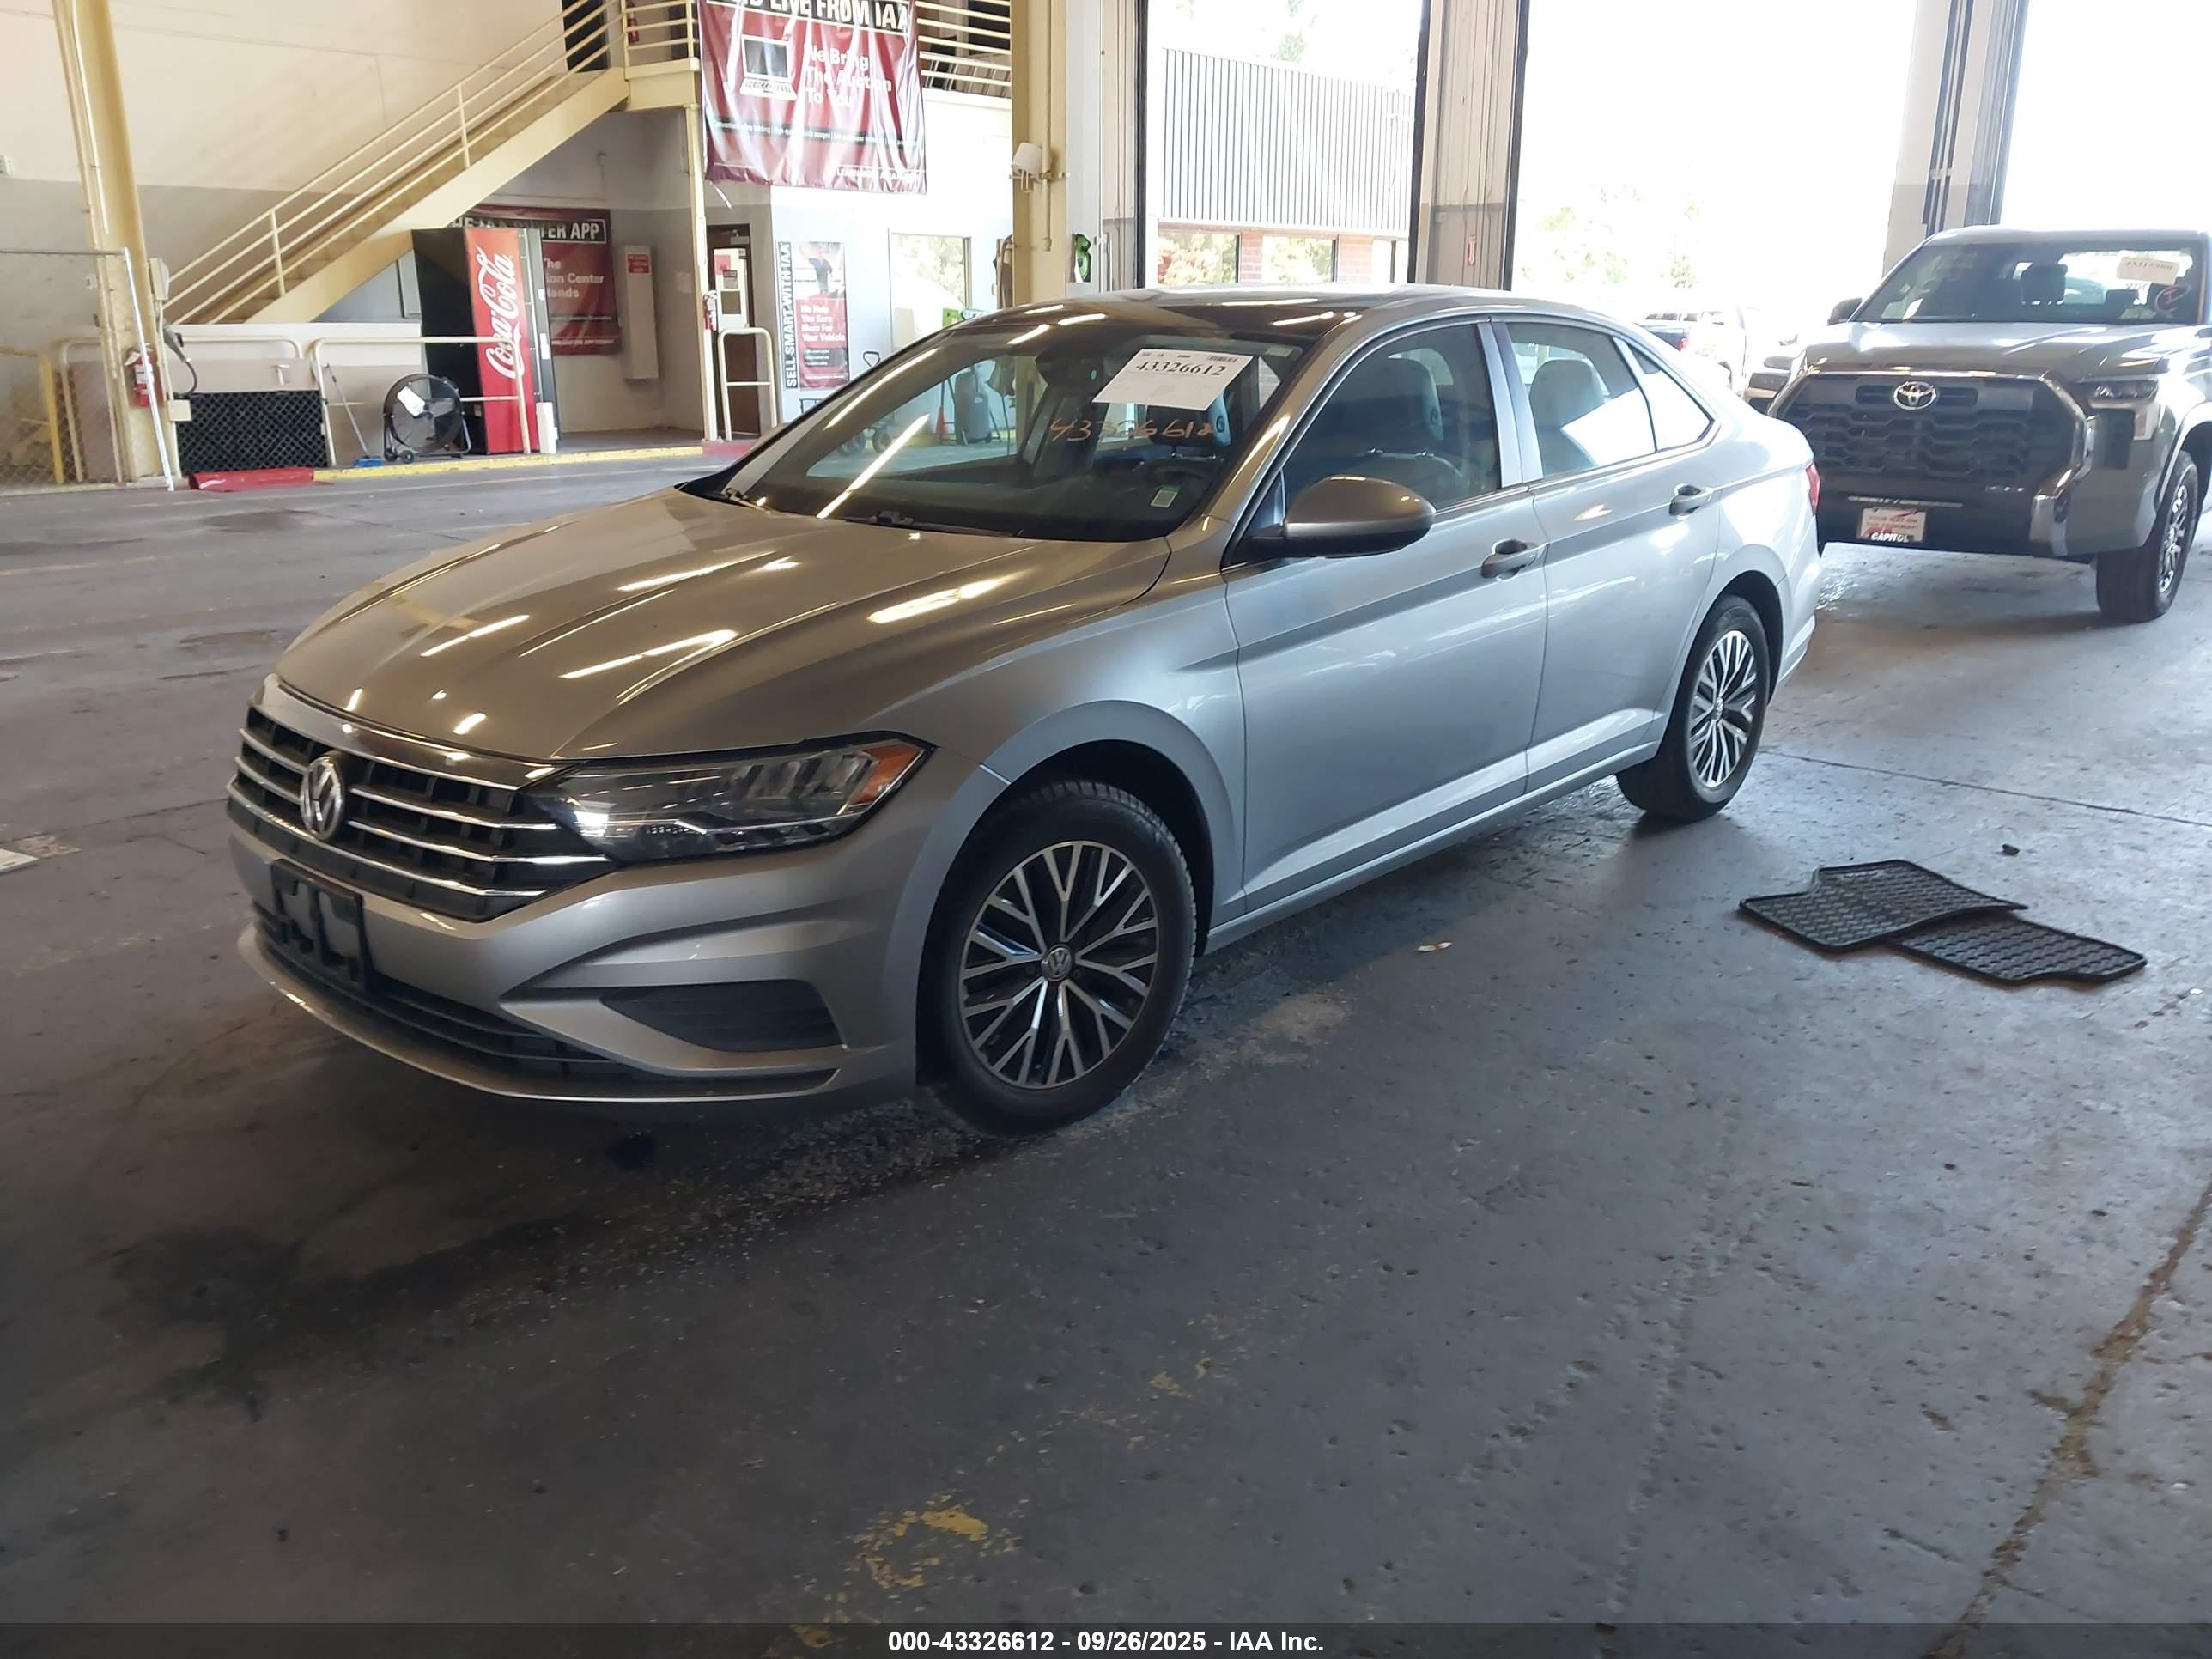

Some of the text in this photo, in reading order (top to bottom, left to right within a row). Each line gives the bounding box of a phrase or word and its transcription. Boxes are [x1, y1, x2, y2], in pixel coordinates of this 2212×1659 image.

[817, 0, 869, 24] FROM
[876, 3, 908, 30] IAA
[836, 70, 892, 91] Aucton
[805, 87, 823, 103] To
[570, 222, 599, 239] APP
[567, 272, 605, 283] Center
[780, 269, 793, 306] WITH
[781, 306, 795, 355] SMART
[785, 356, 798, 388] SELL
[1135, 361, 1226, 376] 43326612
[1870, 532, 1909, 543] CAPITOL
